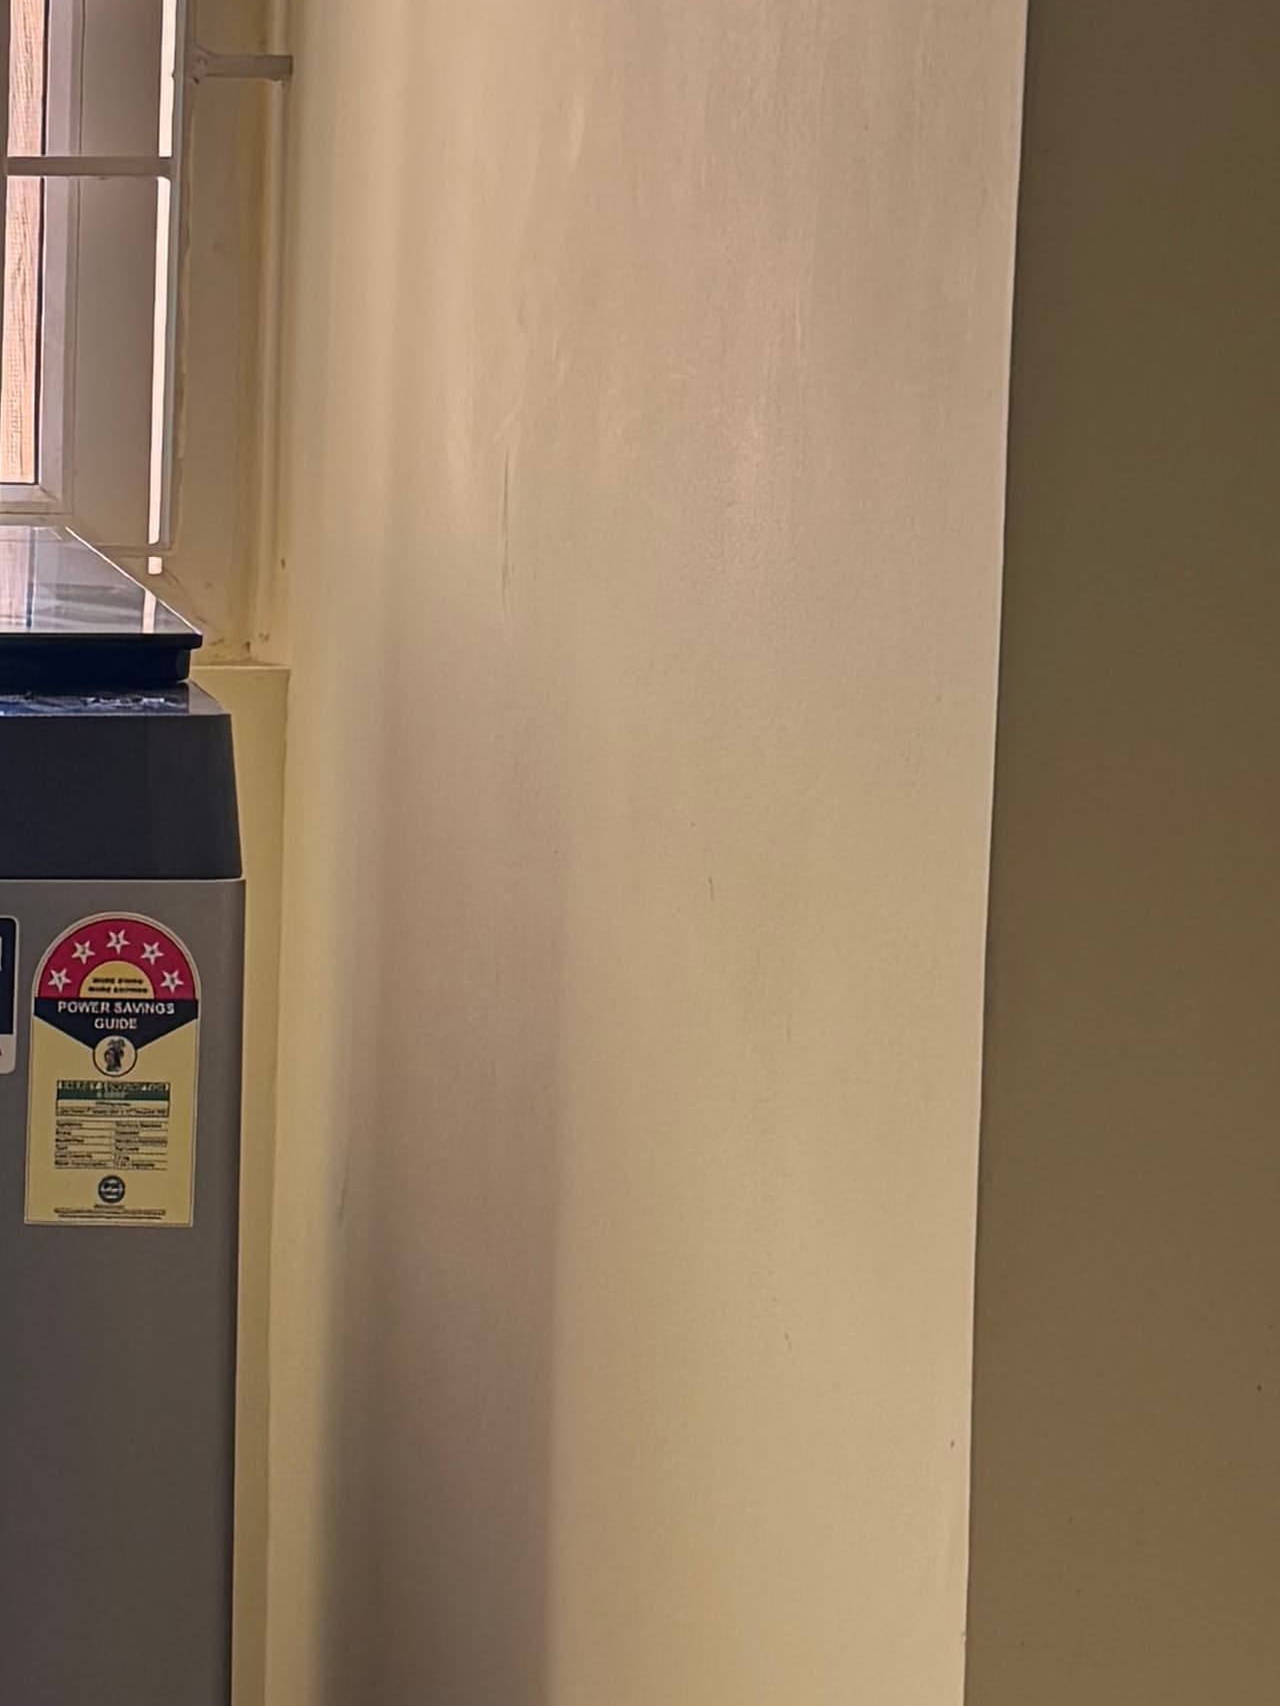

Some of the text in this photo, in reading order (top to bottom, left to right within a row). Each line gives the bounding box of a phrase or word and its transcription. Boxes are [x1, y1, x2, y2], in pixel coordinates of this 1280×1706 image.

[58, 1000, 176, 1015] POWER SAVINGS
[94, 1018, 137, 1030] GUIDE
